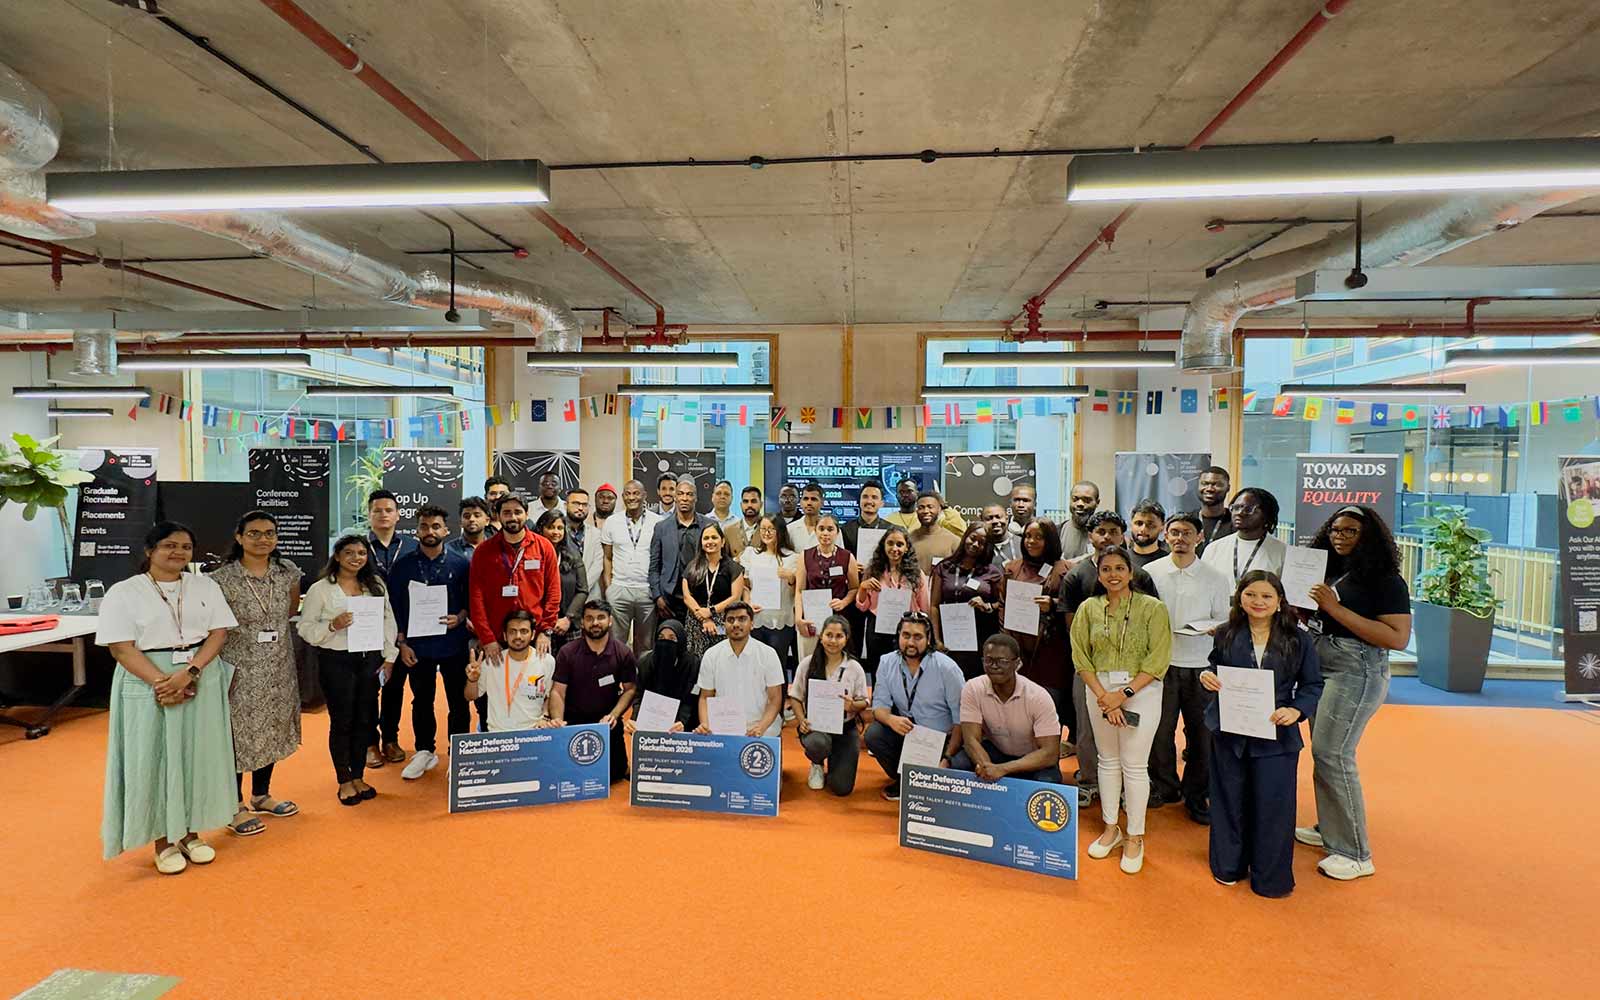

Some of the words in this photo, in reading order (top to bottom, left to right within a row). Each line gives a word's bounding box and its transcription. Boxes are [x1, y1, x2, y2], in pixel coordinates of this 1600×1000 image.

[787, 456, 825, 466] CYBER
[828, 456, 879, 466] DEFENCE
[787, 467, 852, 476] HACKATHON
[854, 467, 879, 476] 2026
[1303, 463, 1386, 476] TOWARDS
[1303, 477, 1346, 489] RACE
[84, 487, 118, 495] Graduate
[256, 489, 298, 497] Conference
[413, 492, 428, 506] Up
[1302, 491, 1381, 506] EQUALITY
[459, 740, 481, 749] Cyber
[483, 738, 514, 746] Defence
[515, 735, 552, 743] Innovation
[639, 737, 660, 745] Cyber
[660, 738, 687, 746] Defence
[689, 739, 724, 748] Innovation
[459, 746, 499, 756] Hackathon
[639, 745, 674, 753] Hackathon
[753, 751, 761, 767] 2
[909, 770, 931, 780] Cyber
[932, 774, 965, 785] Defence
[966, 779, 1008, 792] Innovation
[909, 779, 950, 791] Hackathon
[951, 785, 971, 795] 2026
[908, 801, 931, 812] Winner
[1043, 800, 1051, 819] 1
